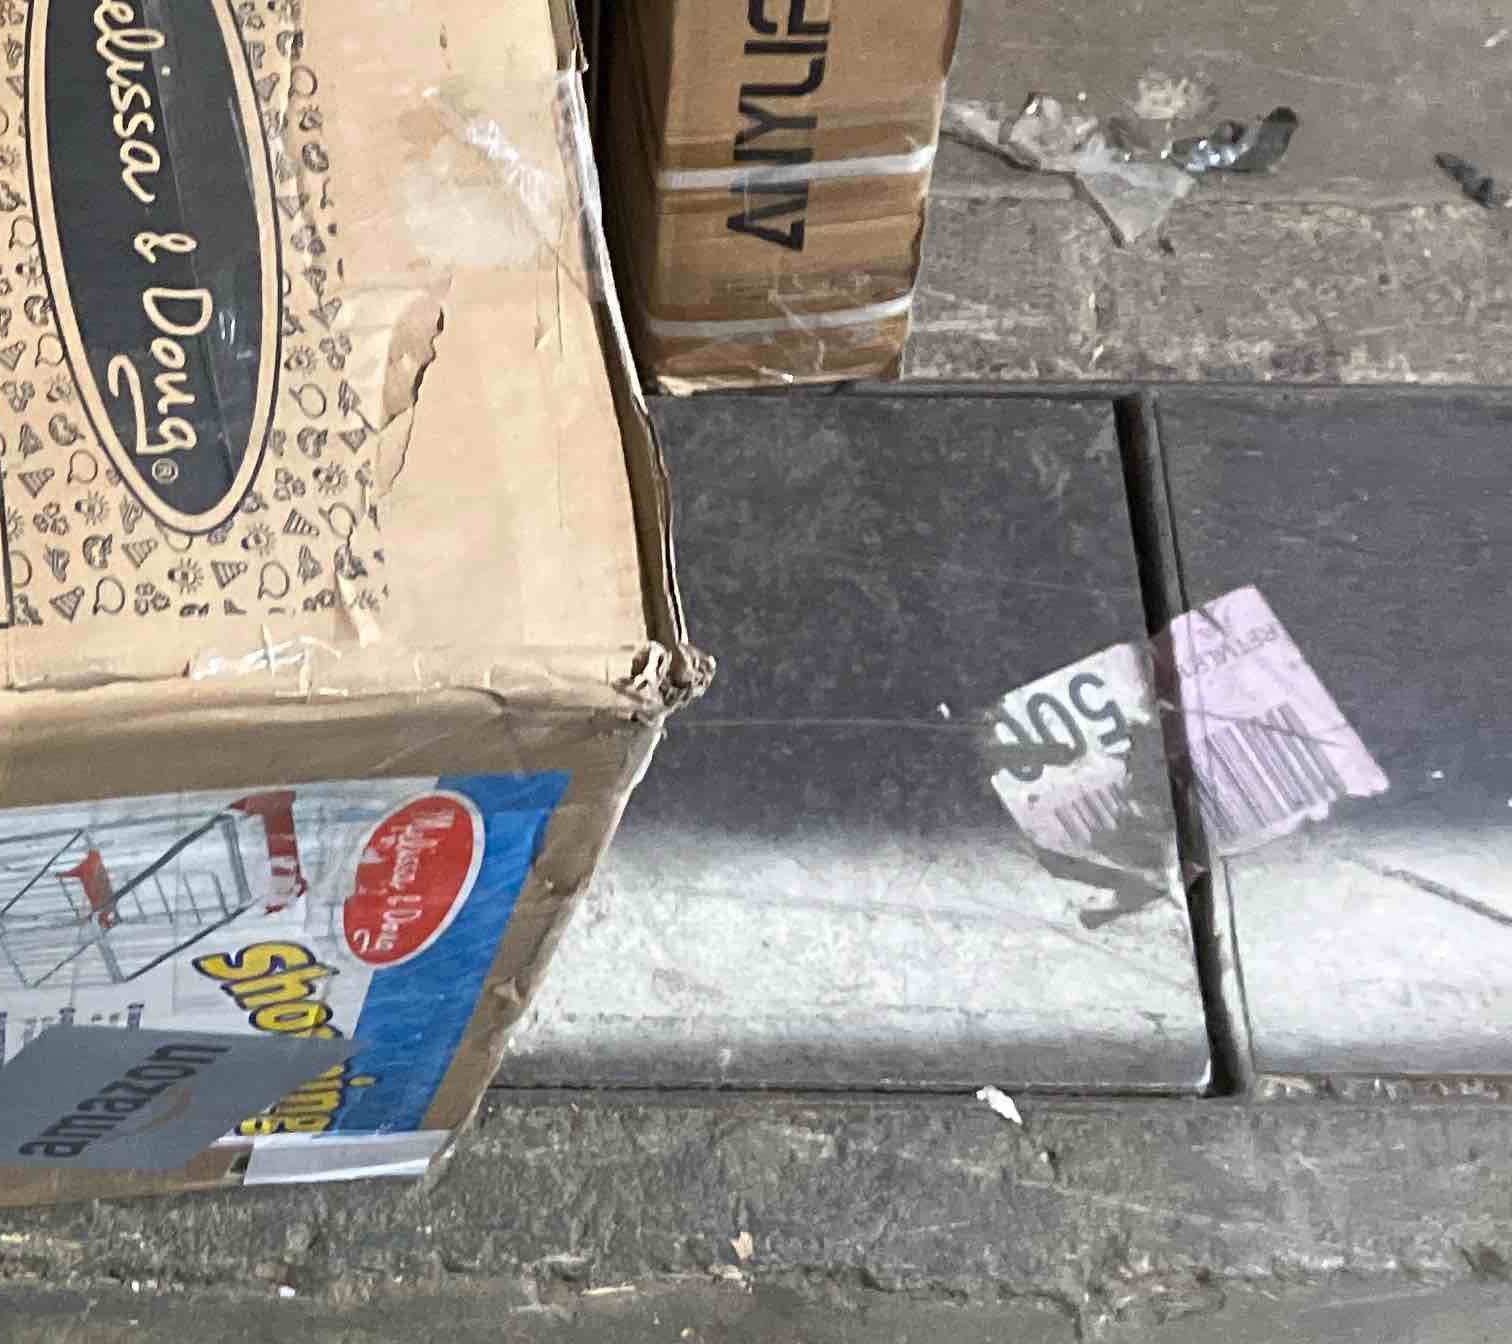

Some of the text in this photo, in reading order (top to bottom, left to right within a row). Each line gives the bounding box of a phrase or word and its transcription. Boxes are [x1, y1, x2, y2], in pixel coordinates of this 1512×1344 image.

[136, 231, 197, 263] &
[193, 942, 382, 1139] Shoing
[18, 1044, 234, 1159] amazon
